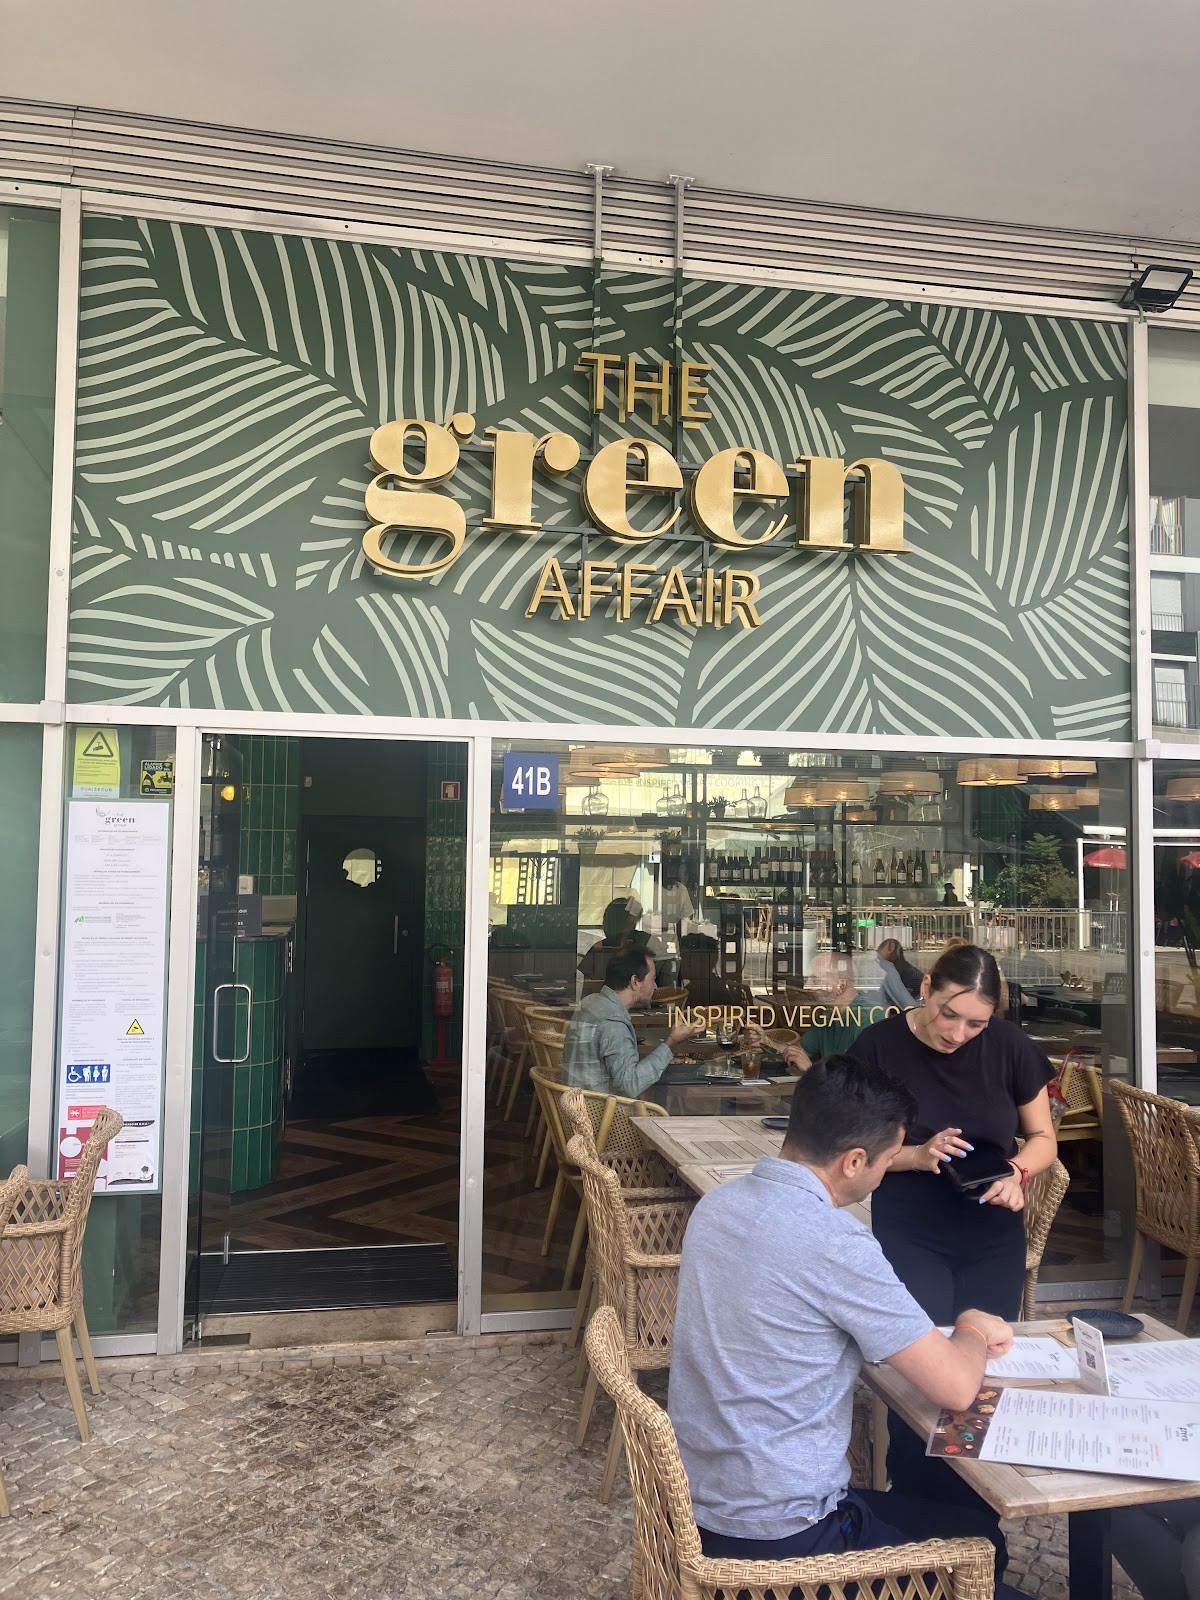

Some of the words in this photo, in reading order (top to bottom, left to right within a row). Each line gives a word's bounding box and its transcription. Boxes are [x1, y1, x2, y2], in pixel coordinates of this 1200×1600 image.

[578, 352, 713, 424] THE
[361, 412, 912, 578] green
[525, 556, 762, 630] AFFAIR
[511, 766, 551, 796] 41B
[104, 816, 135, 825] green
[667, 1005, 776, 1028] INSPIRED
[782, 1005, 862, 1028] VEGAN
